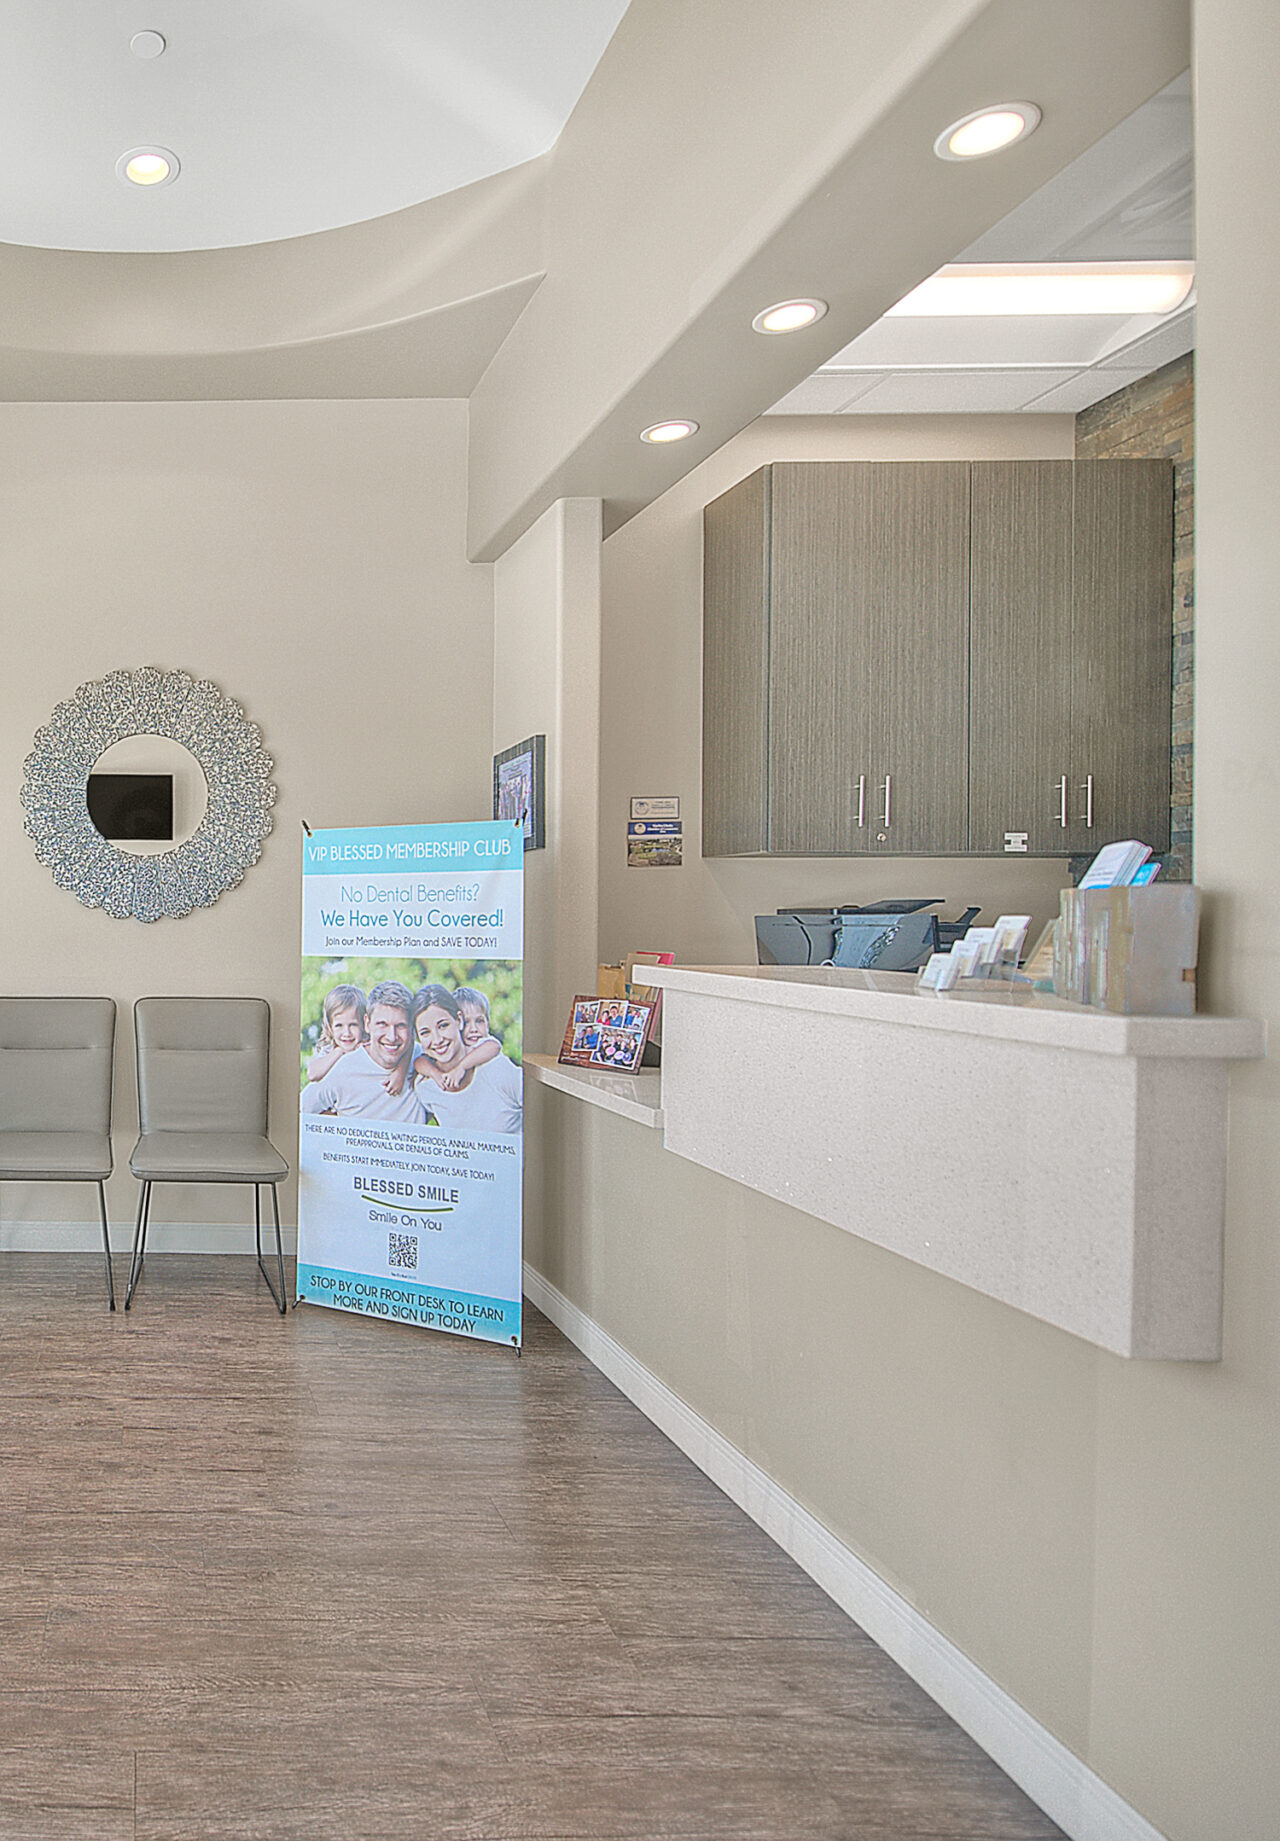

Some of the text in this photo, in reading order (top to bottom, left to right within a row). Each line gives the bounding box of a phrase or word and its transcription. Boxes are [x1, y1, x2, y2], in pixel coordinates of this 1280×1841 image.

[308, 839, 511, 861] VIP BLESSED MEMBERSHIP CLUB
[341, 883, 480, 902] No Dental Benefits?
[320, 908, 503, 927] We Have You Covered!
[325, 936, 497, 948] Join our Membership Plan and SAVE TODAY!
[305, 1124, 323, 1133] THERE
[324, 1126, 335, 1135] ARE
[336, 1127, 348, 1136] NO
[448, 1139, 476, 1150] ANNUAL
[394, 1142, 405, 1152] OR
[405, 1143, 432, 1155] DENIALS
[433, 1147, 442, 1156] OF
[323, 1152, 350, 1164] BENEFITS
[351, 1155, 369, 1165] START
[411, 1163, 426, 1172] JOIN
[451, 1167, 468, 1178] SAVE
[354, 1176, 459, 1204] BLESSED SMILE
[368, 1209, 442, 1231] Smile On You
[310, 1275, 504, 1322] STOP BY OUR FRONT DESK TO LEARN
[333, 1293, 477, 1333] MORE AND SIGN UP TODAY
